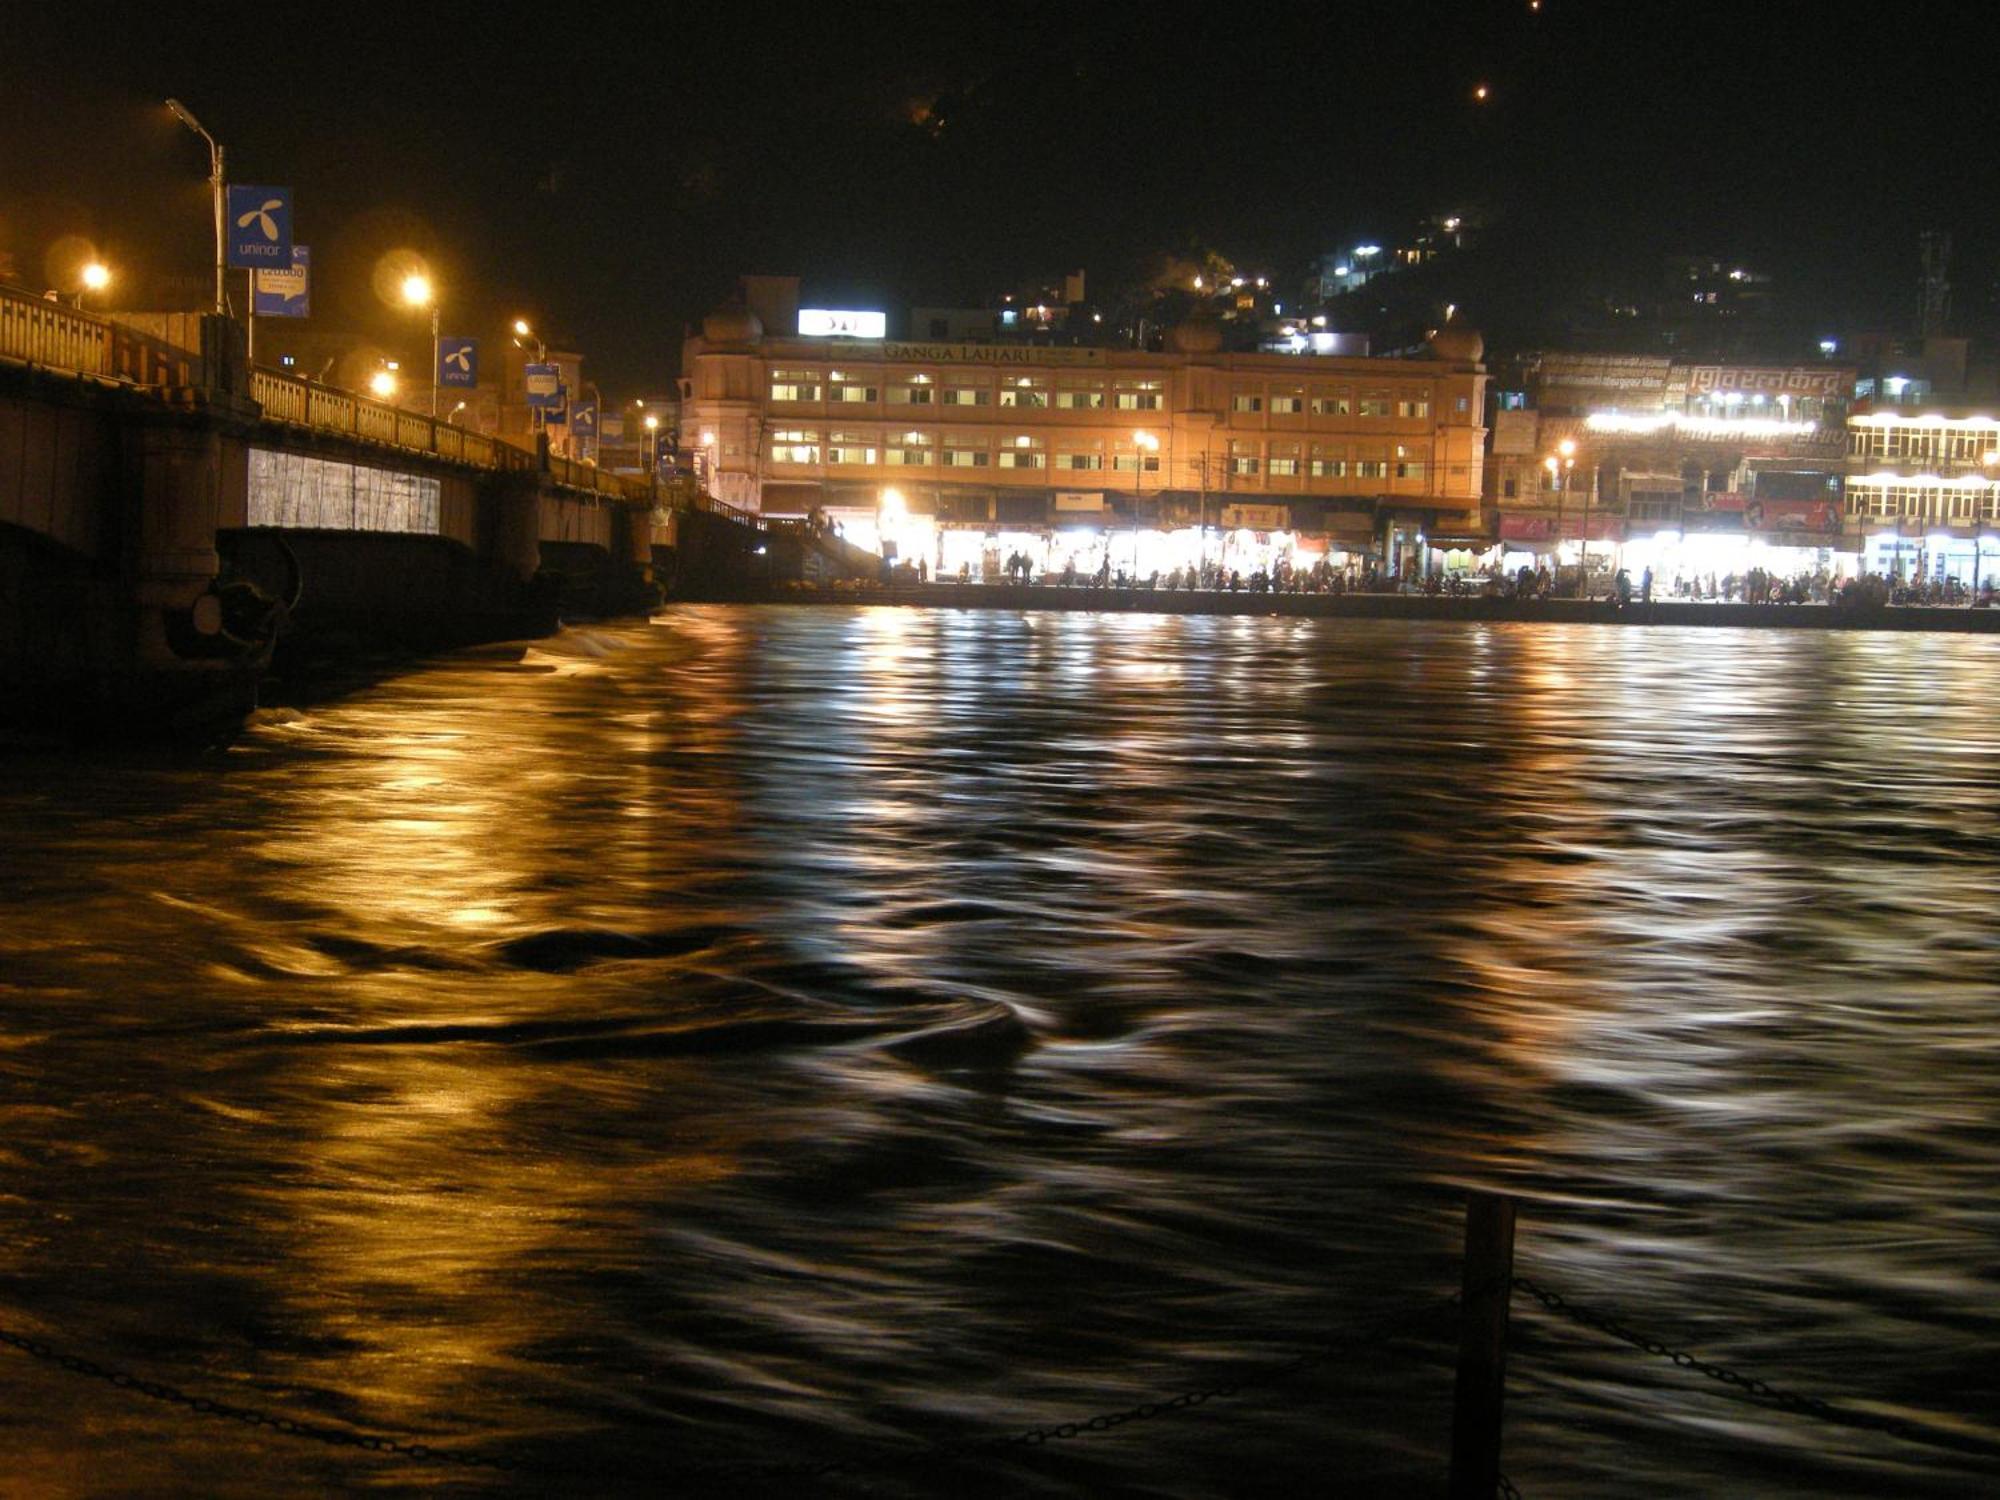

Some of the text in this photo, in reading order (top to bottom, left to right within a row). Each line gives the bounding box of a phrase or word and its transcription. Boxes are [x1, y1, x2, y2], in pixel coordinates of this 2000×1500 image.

[239, 243, 281, 256] uninor
[884, 344, 1032, 362] GANGA LAHARI
[1691, 366, 1737, 393] शिव
[1740, 368, 1786, 390] रत्न
